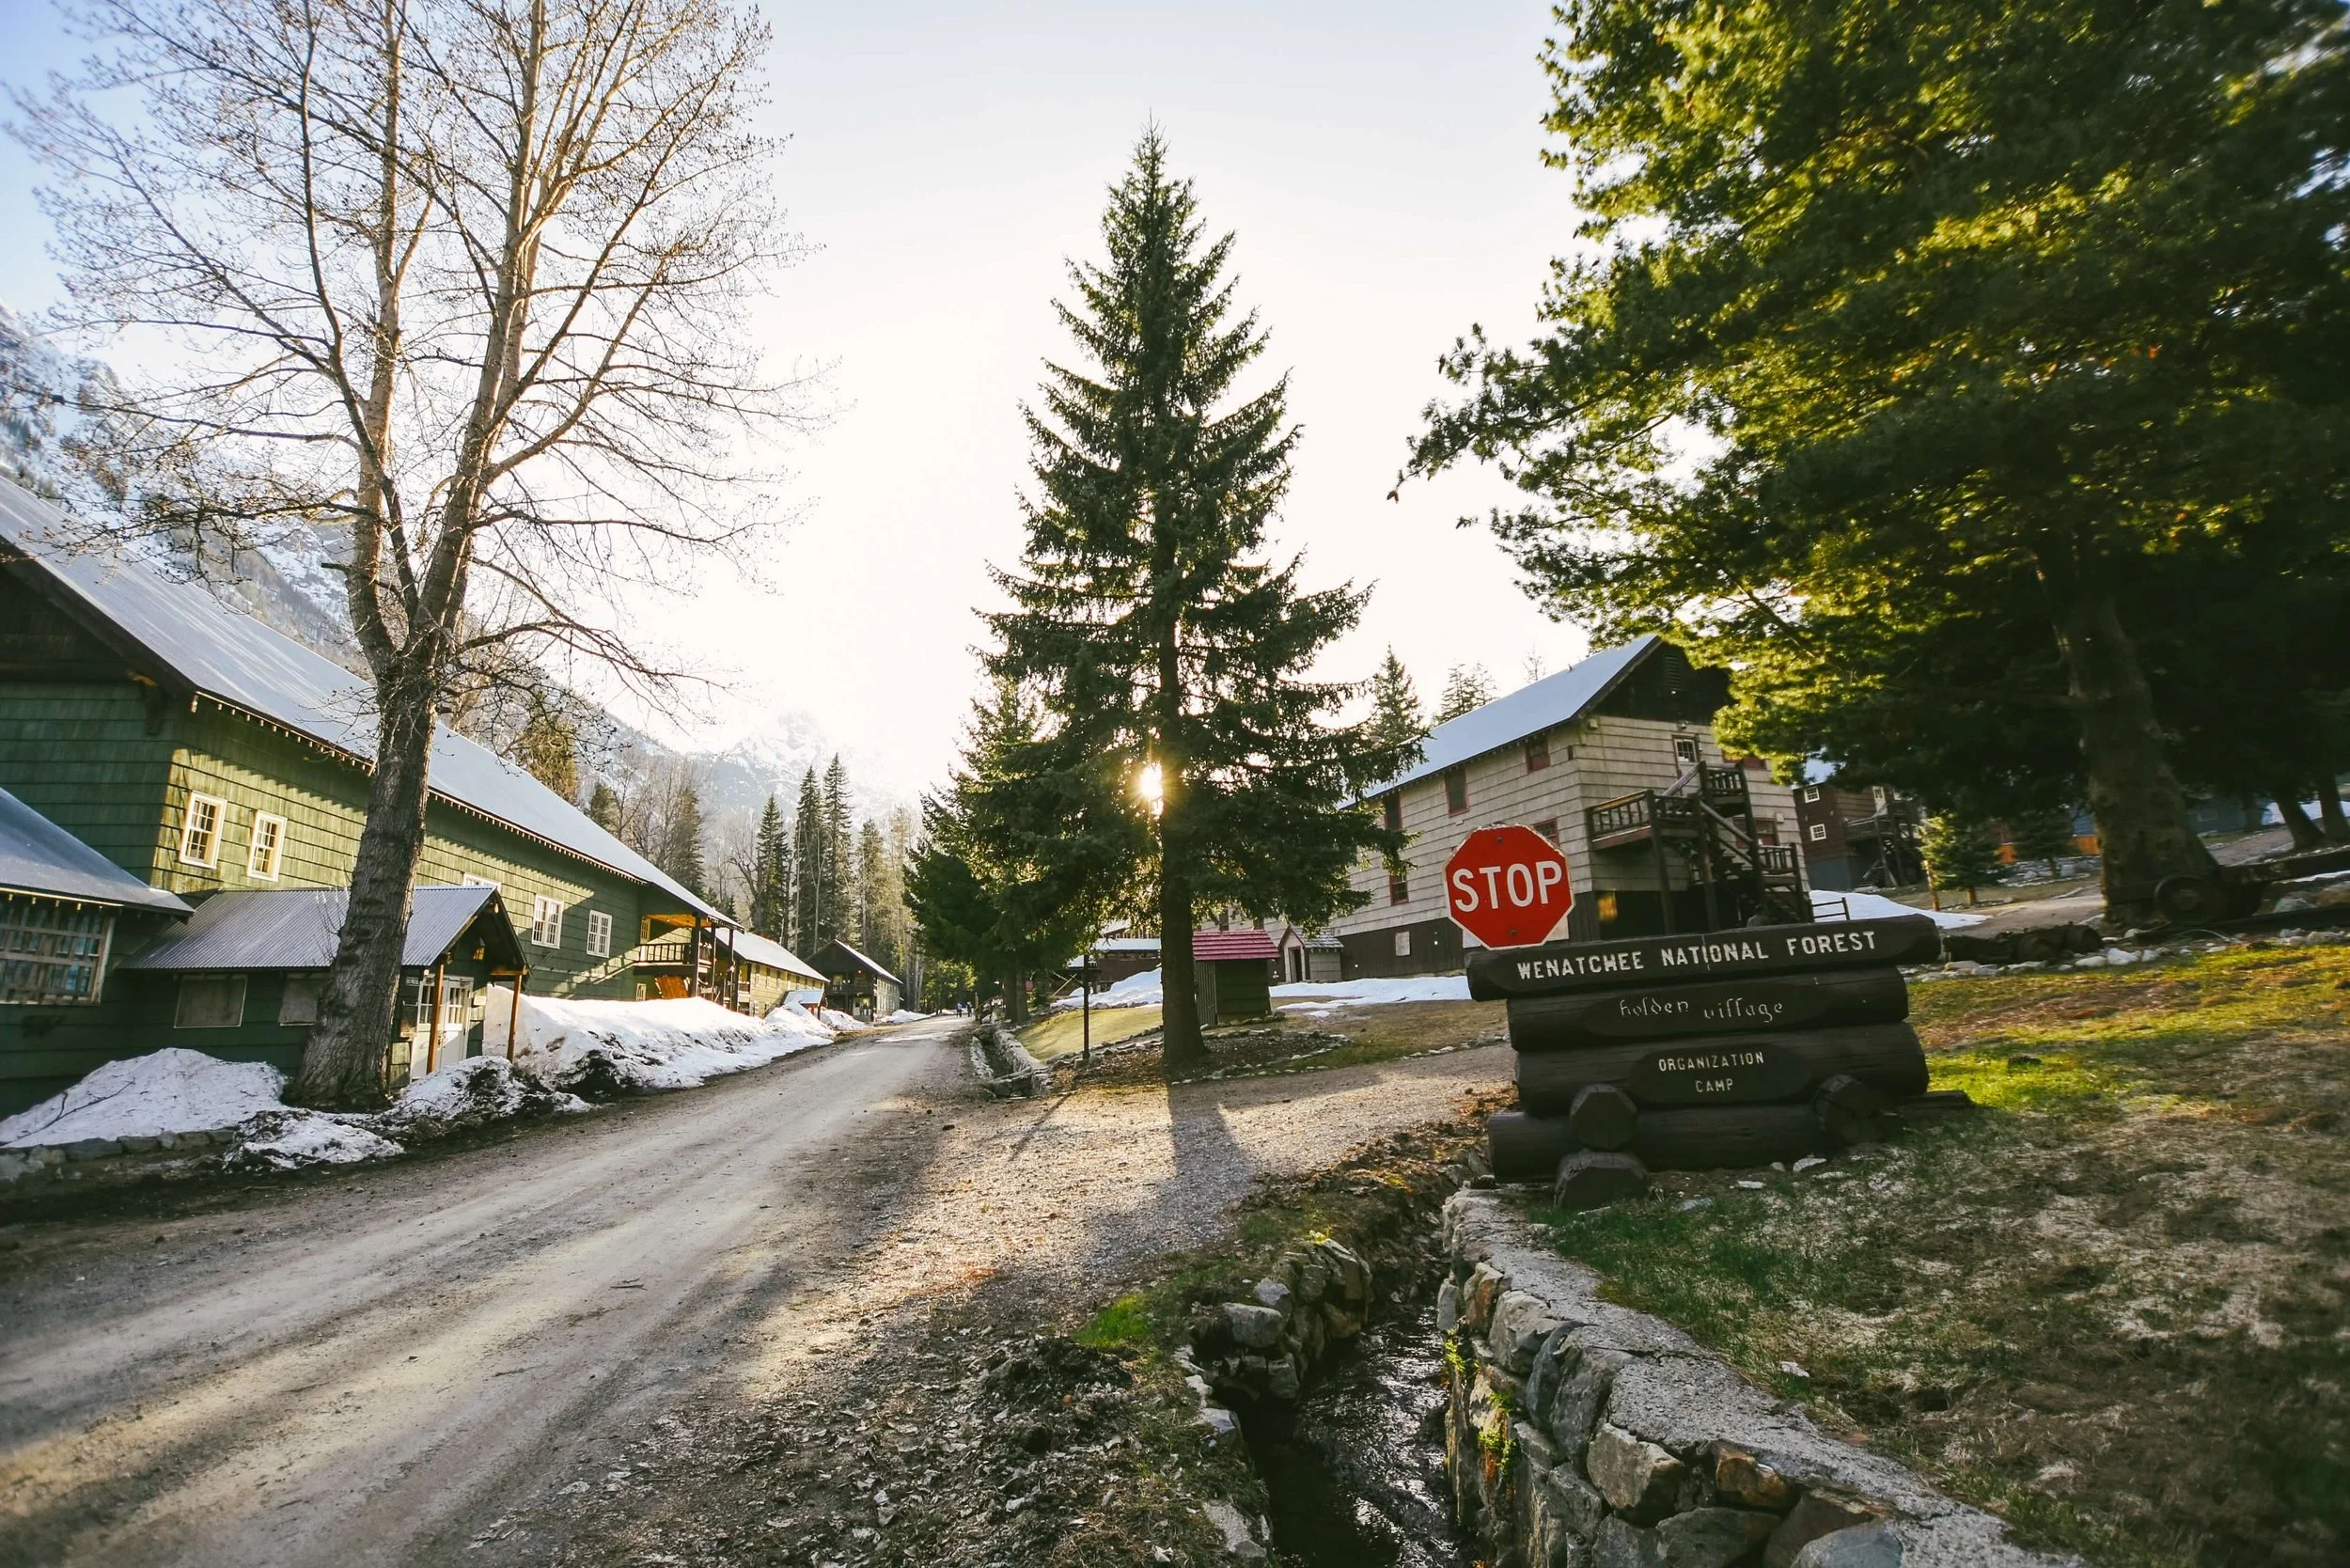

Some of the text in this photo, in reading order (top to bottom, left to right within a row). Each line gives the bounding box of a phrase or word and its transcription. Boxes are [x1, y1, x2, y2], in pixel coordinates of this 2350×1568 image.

[1452, 860, 1562, 912] STOP
[1517, 931, 1876, 980] WENATCHEE NATIONAL FOREST
[1658, 1051, 1764, 1072] ORGANIZATION
[1696, 1078, 1733, 1092] CAMP
